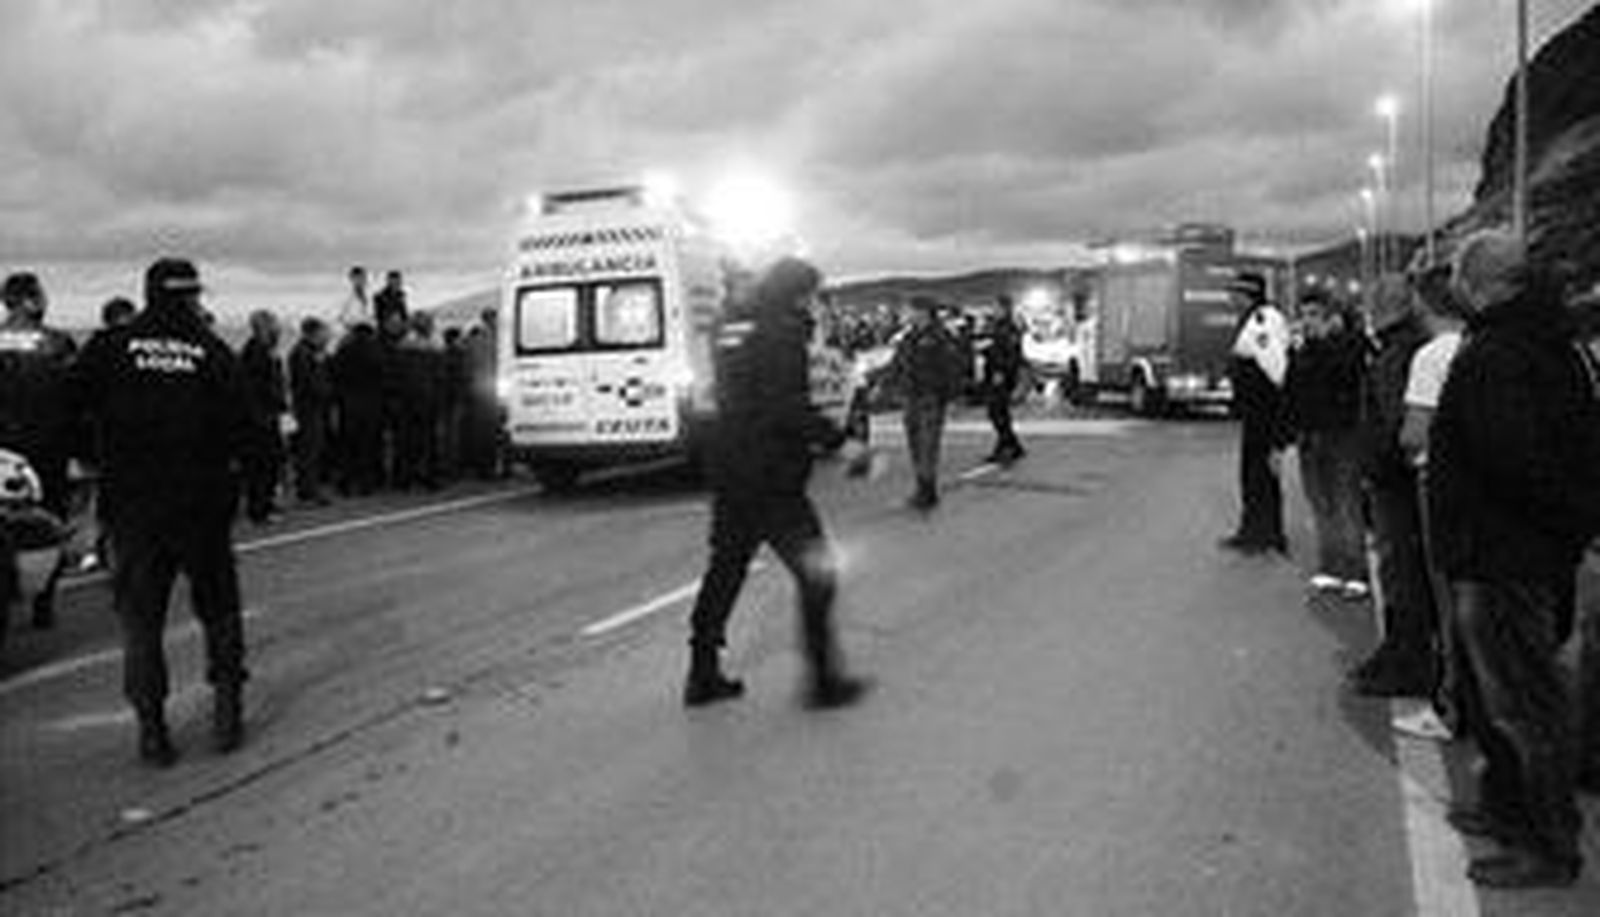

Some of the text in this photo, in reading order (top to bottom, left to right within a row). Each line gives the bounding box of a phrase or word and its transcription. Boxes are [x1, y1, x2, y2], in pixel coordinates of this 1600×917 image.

[519, 254, 657, 279] AMBULANCIA
[136, 354, 197, 373] LOCAL
[596, 418, 671, 435] CEUTA
